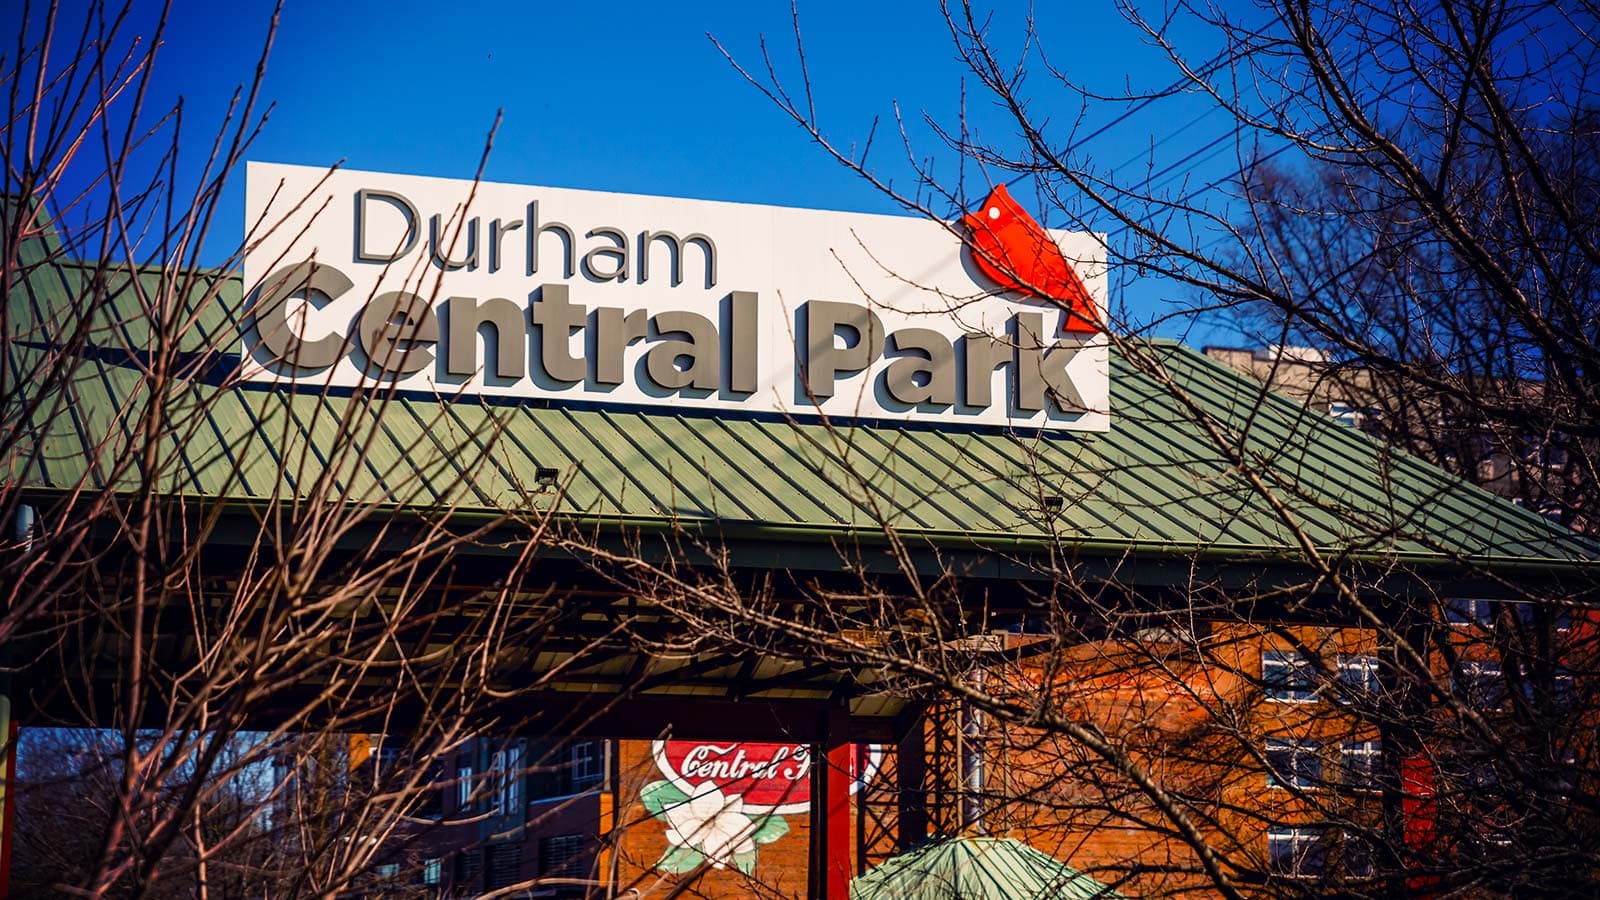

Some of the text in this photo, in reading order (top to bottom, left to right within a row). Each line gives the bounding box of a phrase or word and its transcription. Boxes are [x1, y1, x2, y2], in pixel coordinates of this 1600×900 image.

[354, 188, 717, 290] Durham
[247, 261, 1088, 420] Central Park
[681, 744, 789, 780] Central
